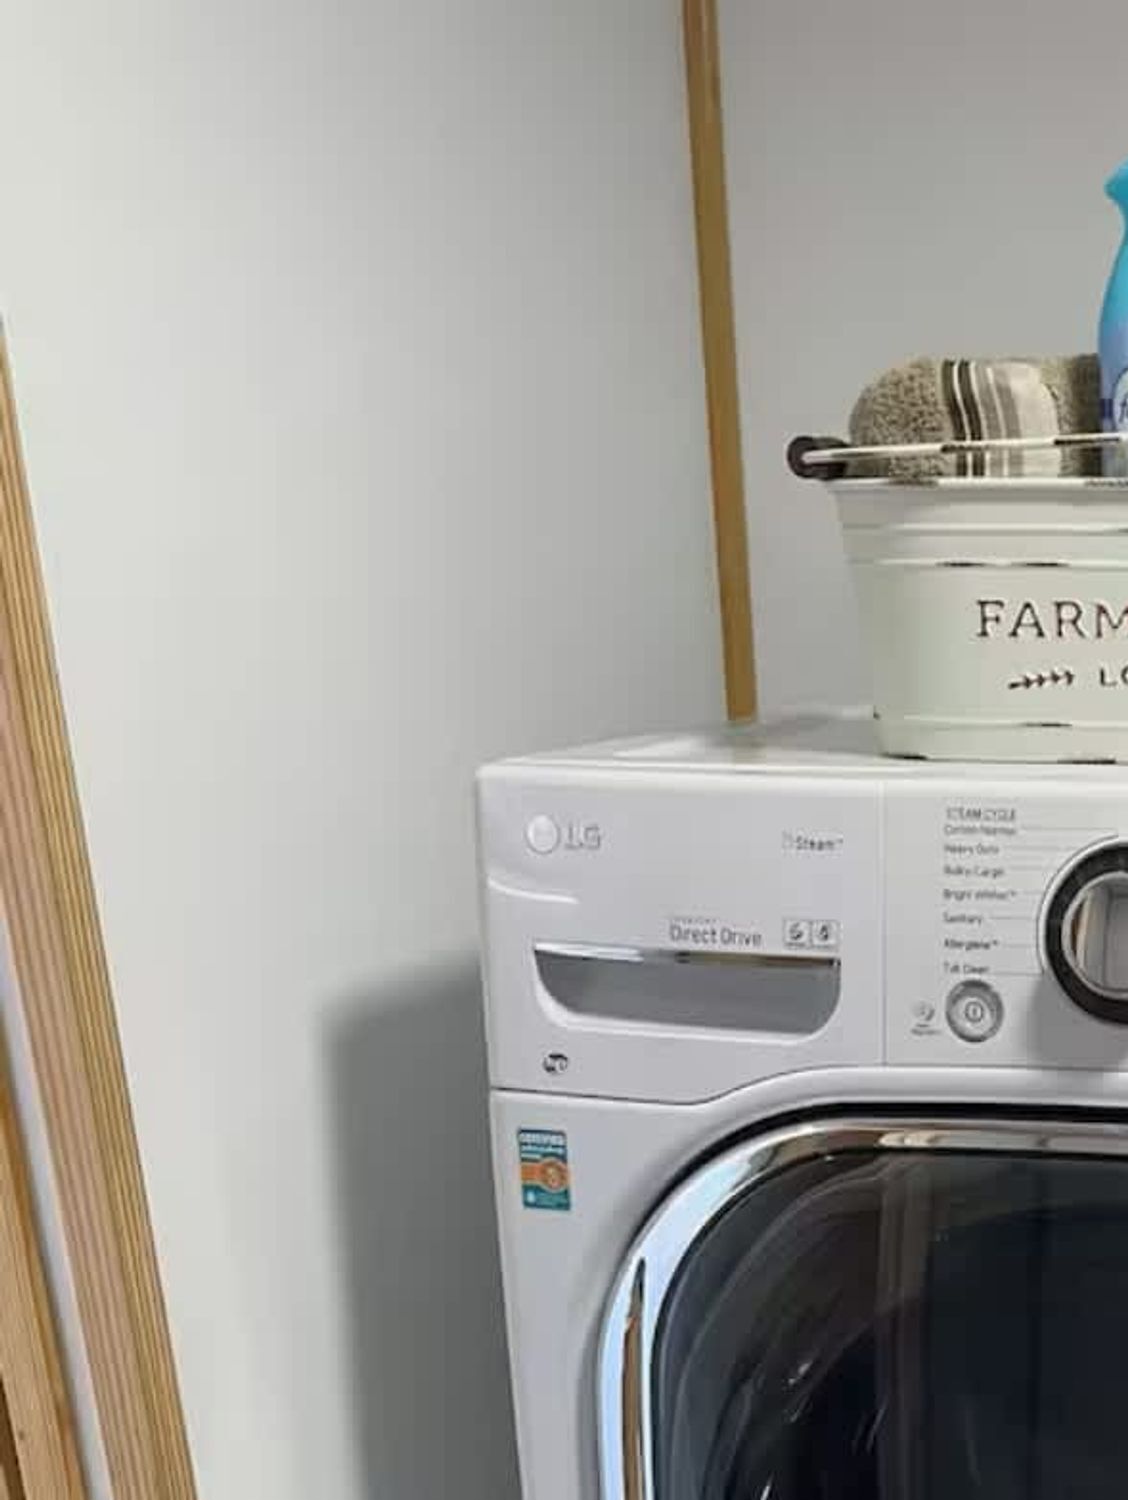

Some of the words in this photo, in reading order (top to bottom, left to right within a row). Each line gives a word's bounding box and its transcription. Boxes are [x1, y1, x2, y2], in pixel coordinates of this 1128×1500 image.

[564, 822, 602, 850] LG
[669, 923, 717, 944] Direct
[720, 927, 763, 946] Drive
